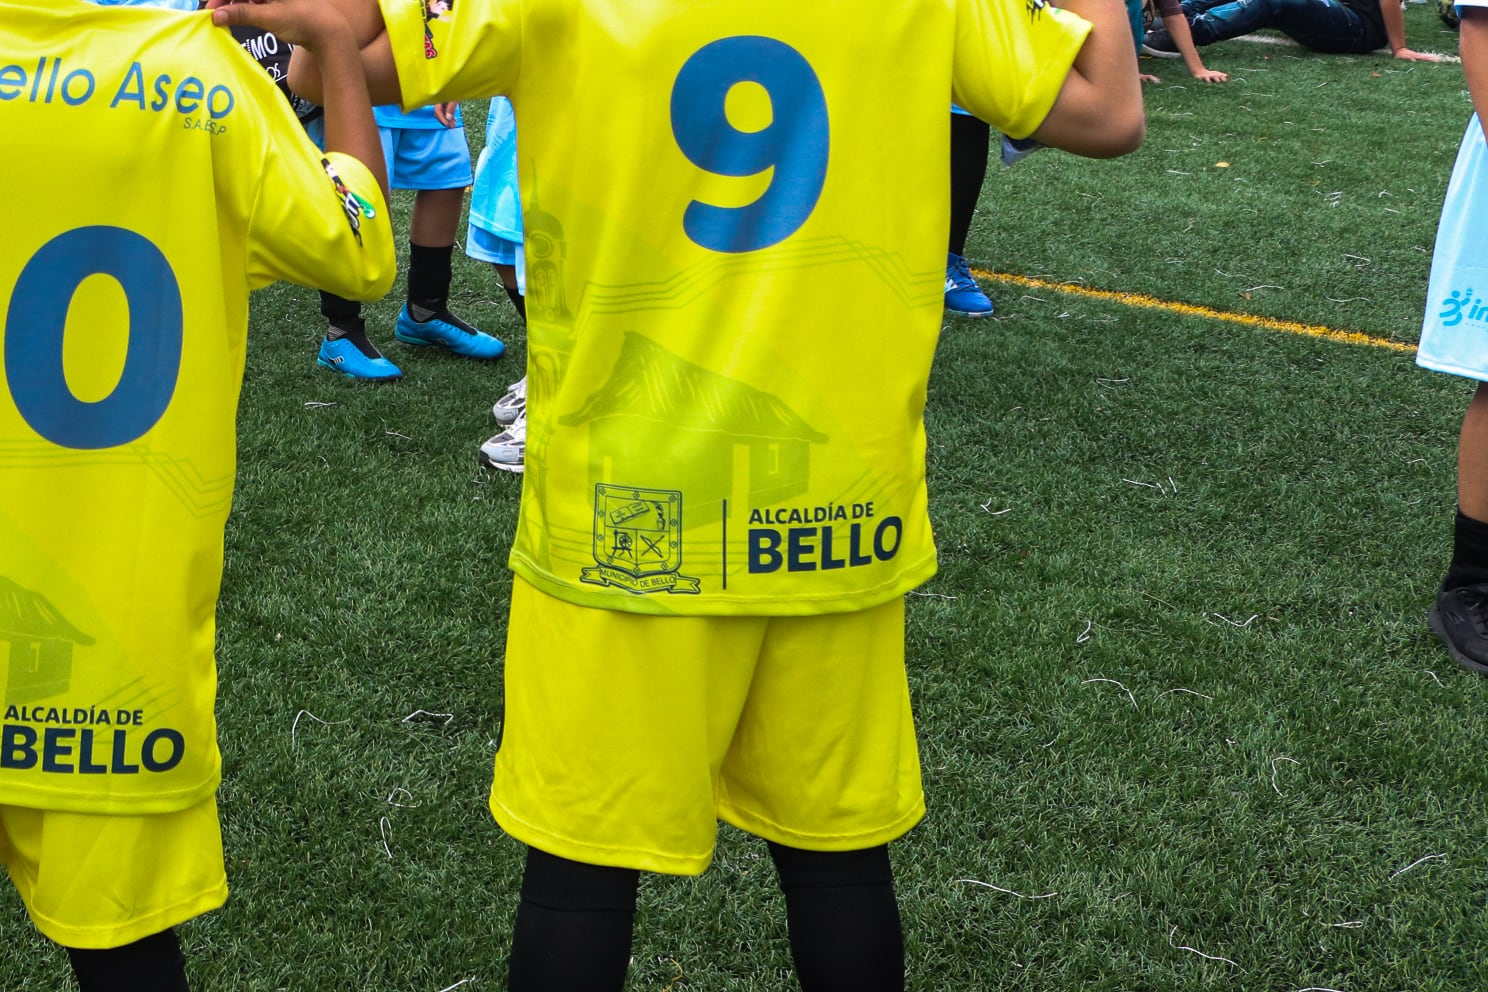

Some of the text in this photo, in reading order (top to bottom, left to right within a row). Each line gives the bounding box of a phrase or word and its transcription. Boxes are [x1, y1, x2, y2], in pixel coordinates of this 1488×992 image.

[110, 61, 234, 119] Aseo
[670, 35, 830, 253] 9
[748, 502, 874, 524] ALCALDÍA DE
[748, 516, 902, 574] BELLO
[651, 574, 677, 586] BELLO
[3, 705, 143, 726] ALCALDÍA DE
[0, 724, 185, 774] BELLO
